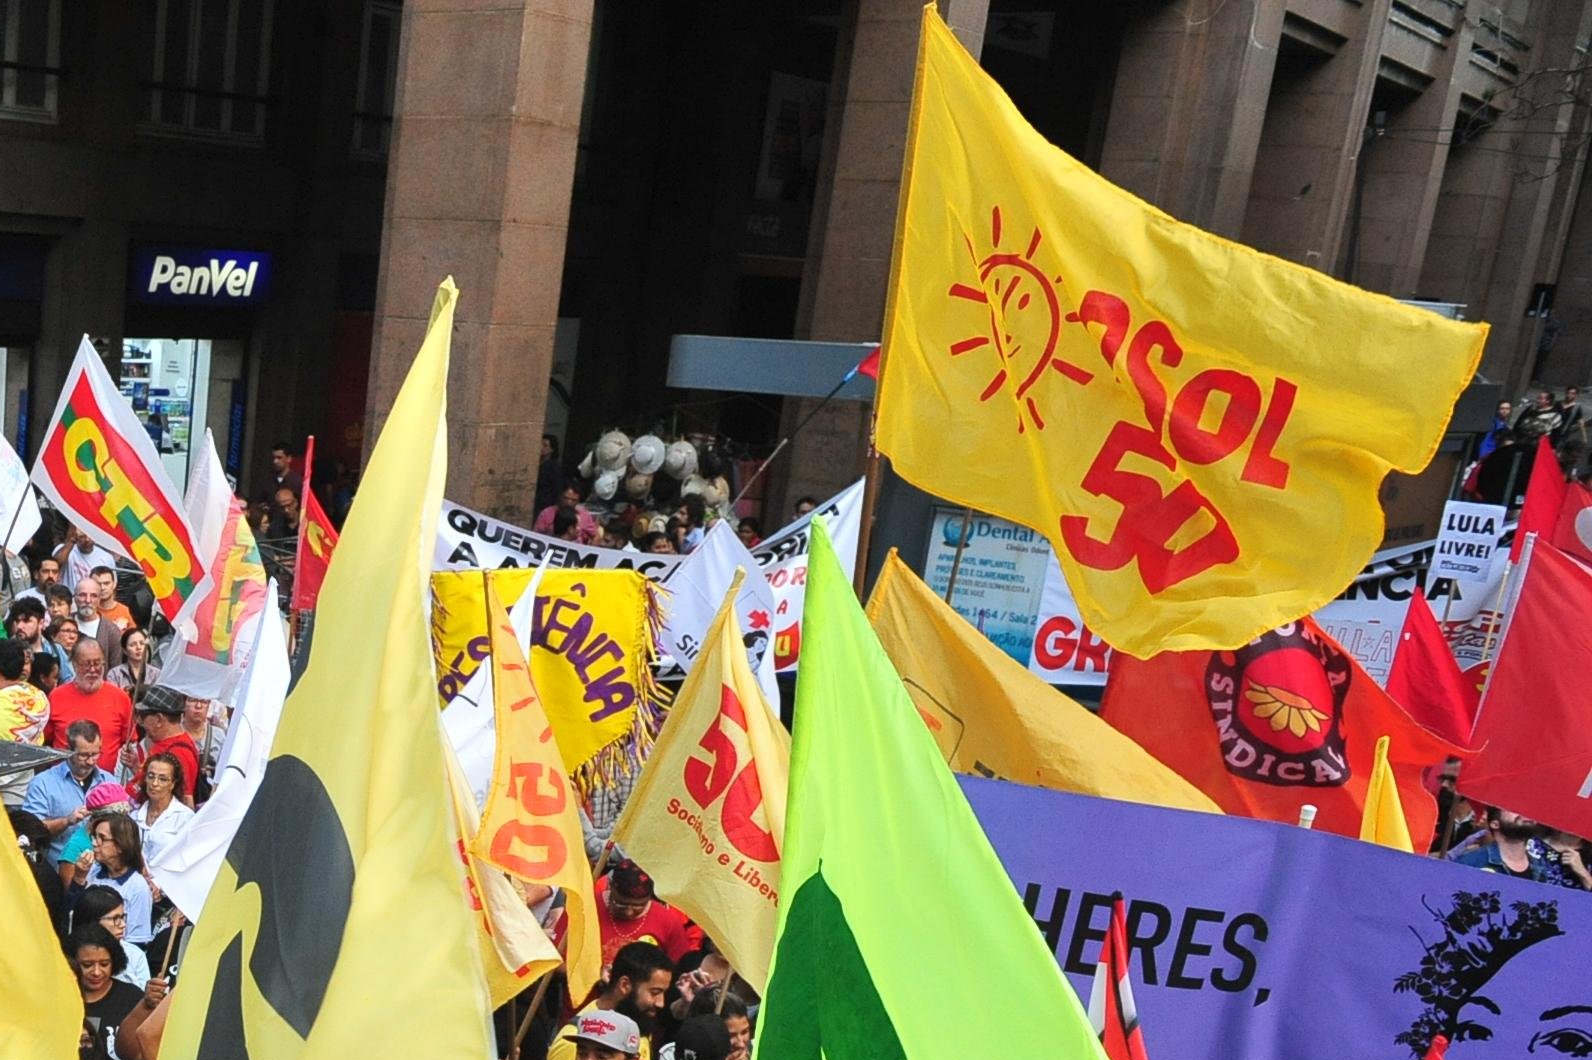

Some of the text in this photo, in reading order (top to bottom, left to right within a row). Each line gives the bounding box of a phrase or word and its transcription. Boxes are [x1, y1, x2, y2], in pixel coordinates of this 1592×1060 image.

[148, 256, 259, 297] PanVel
[63, 417, 191, 599] CTB
[977, 521, 1035, 543] Dental
[1446, 513, 1496, 536] LULA
[447, 509, 599, 569] QUEREM
[1439, 540, 1491, 560] LIVRE!
[717, 853, 731, 867] e
